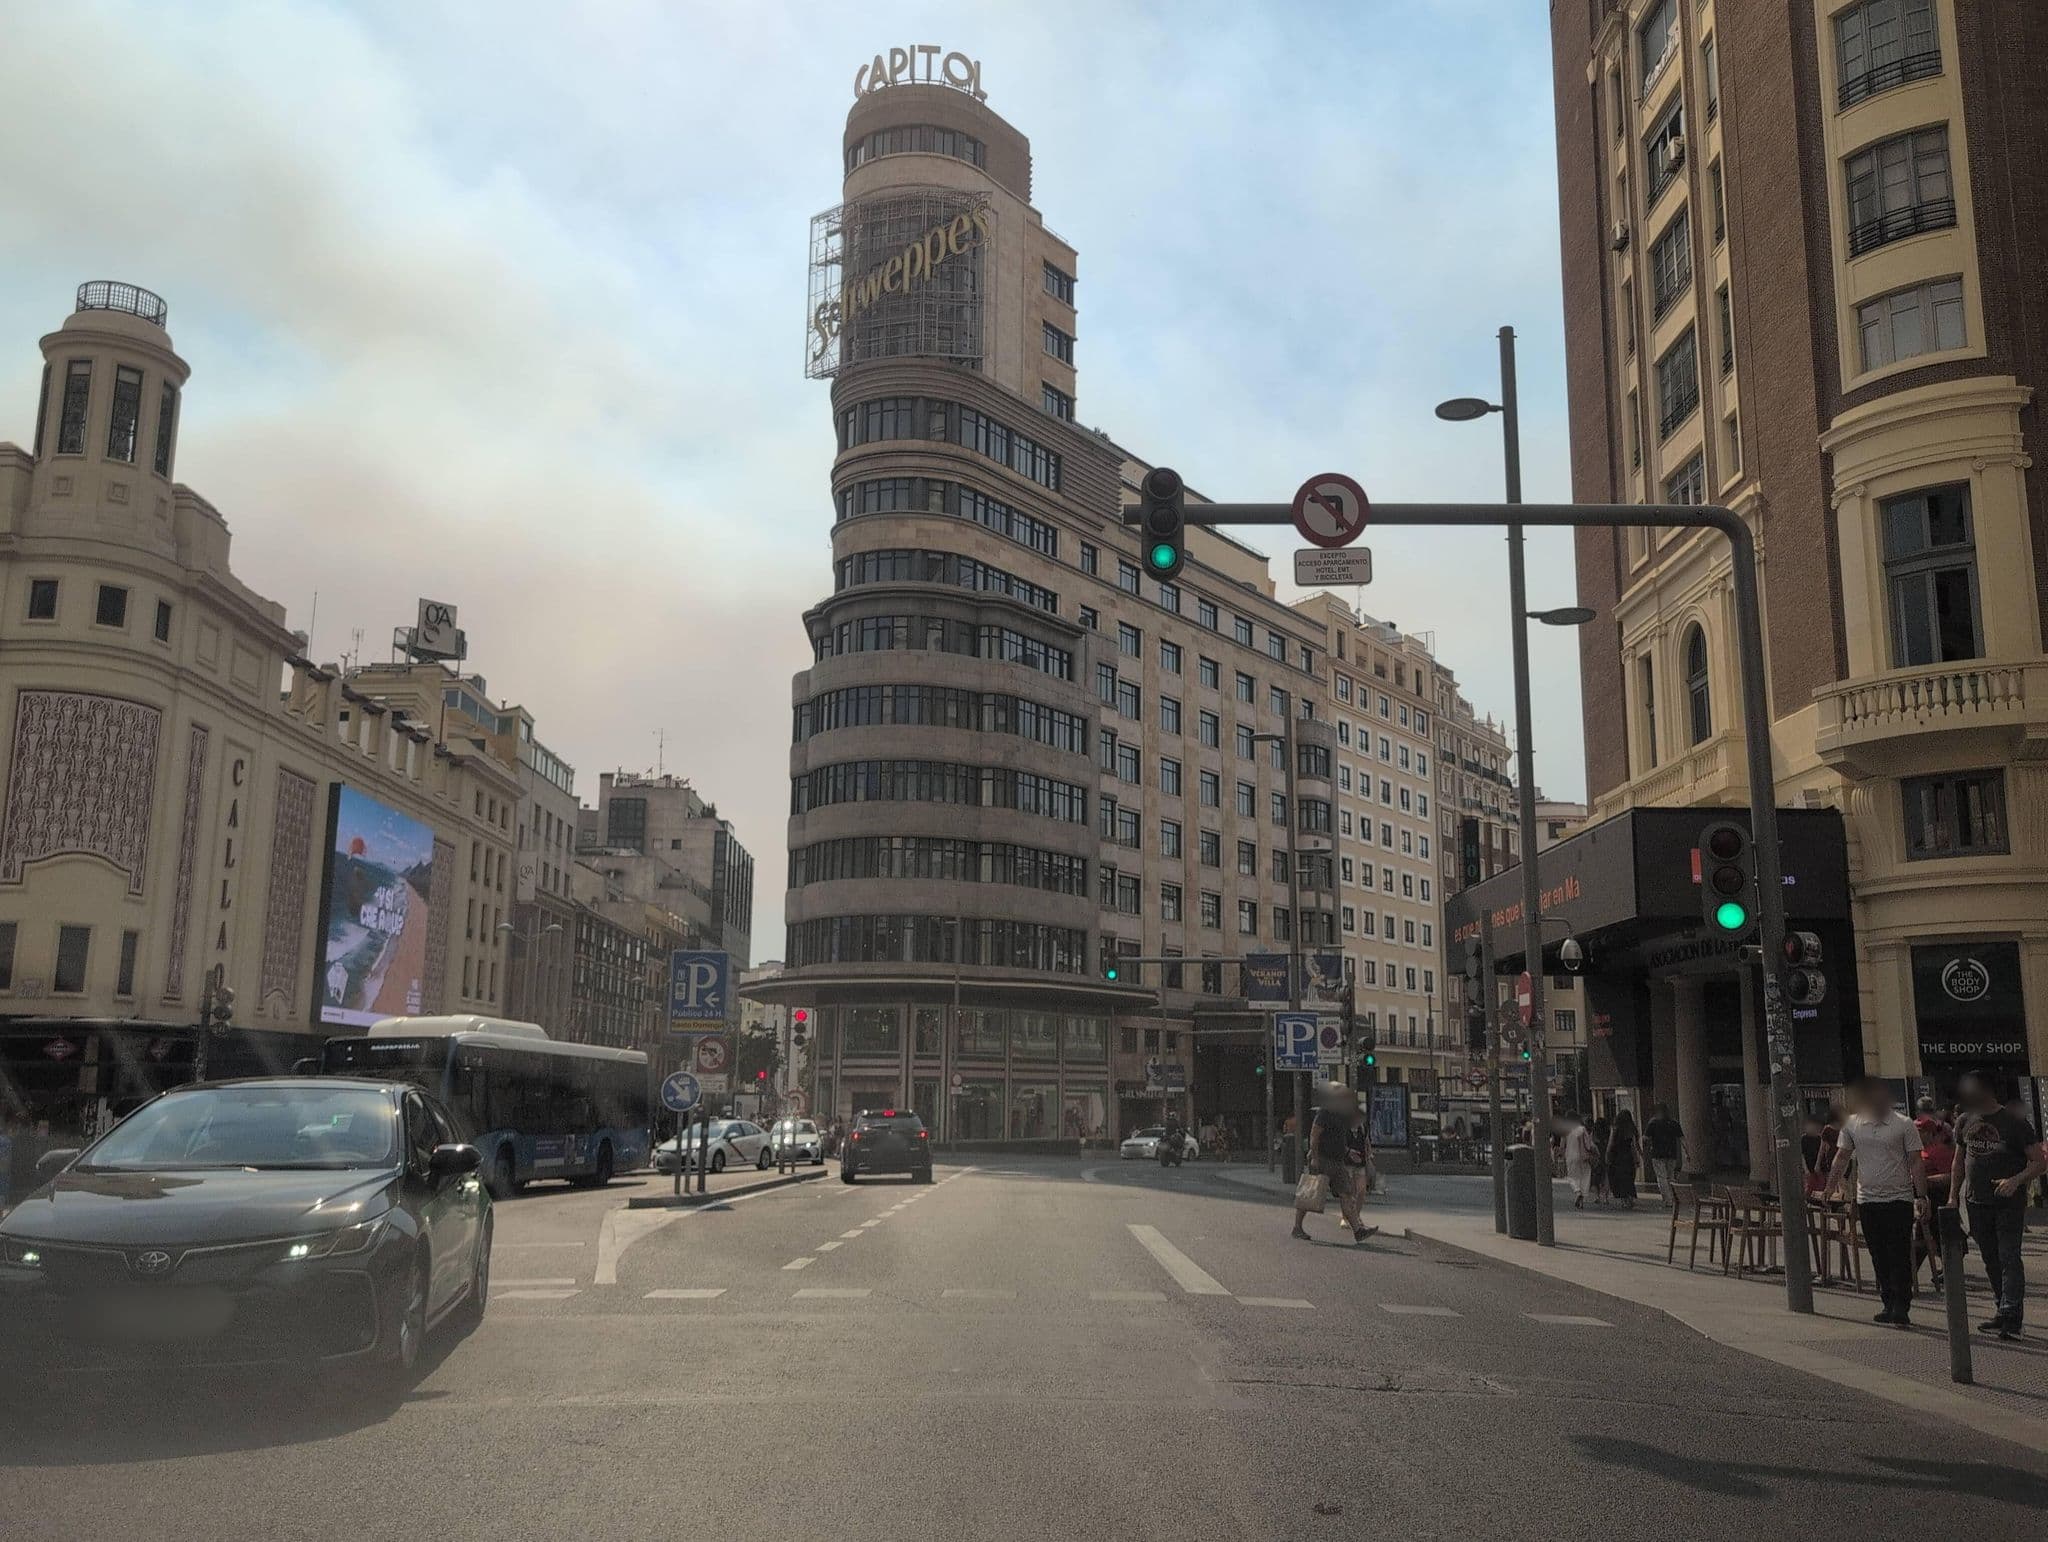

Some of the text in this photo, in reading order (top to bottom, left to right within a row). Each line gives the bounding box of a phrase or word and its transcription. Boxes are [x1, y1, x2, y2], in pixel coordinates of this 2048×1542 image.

[854, 44, 988, 101] CAPITOL
[812, 201, 992, 361] Schweppes
[1319, 552, 1347, 560] EXCEPTO
[213, 758, 244, 990] CALLAO
[1553, 886, 1564, 905] en
[1955, 970, 1974, 978] THE
[1258, 978, 1282, 987] VILLA
[1951, 978, 1981, 987] BODY
[1953, 985, 1981, 994] SHOP
[1793, 1008, 1818, 1021] Empresas
[1921, 1043, 2022, 1054] THE BODY SHOP
